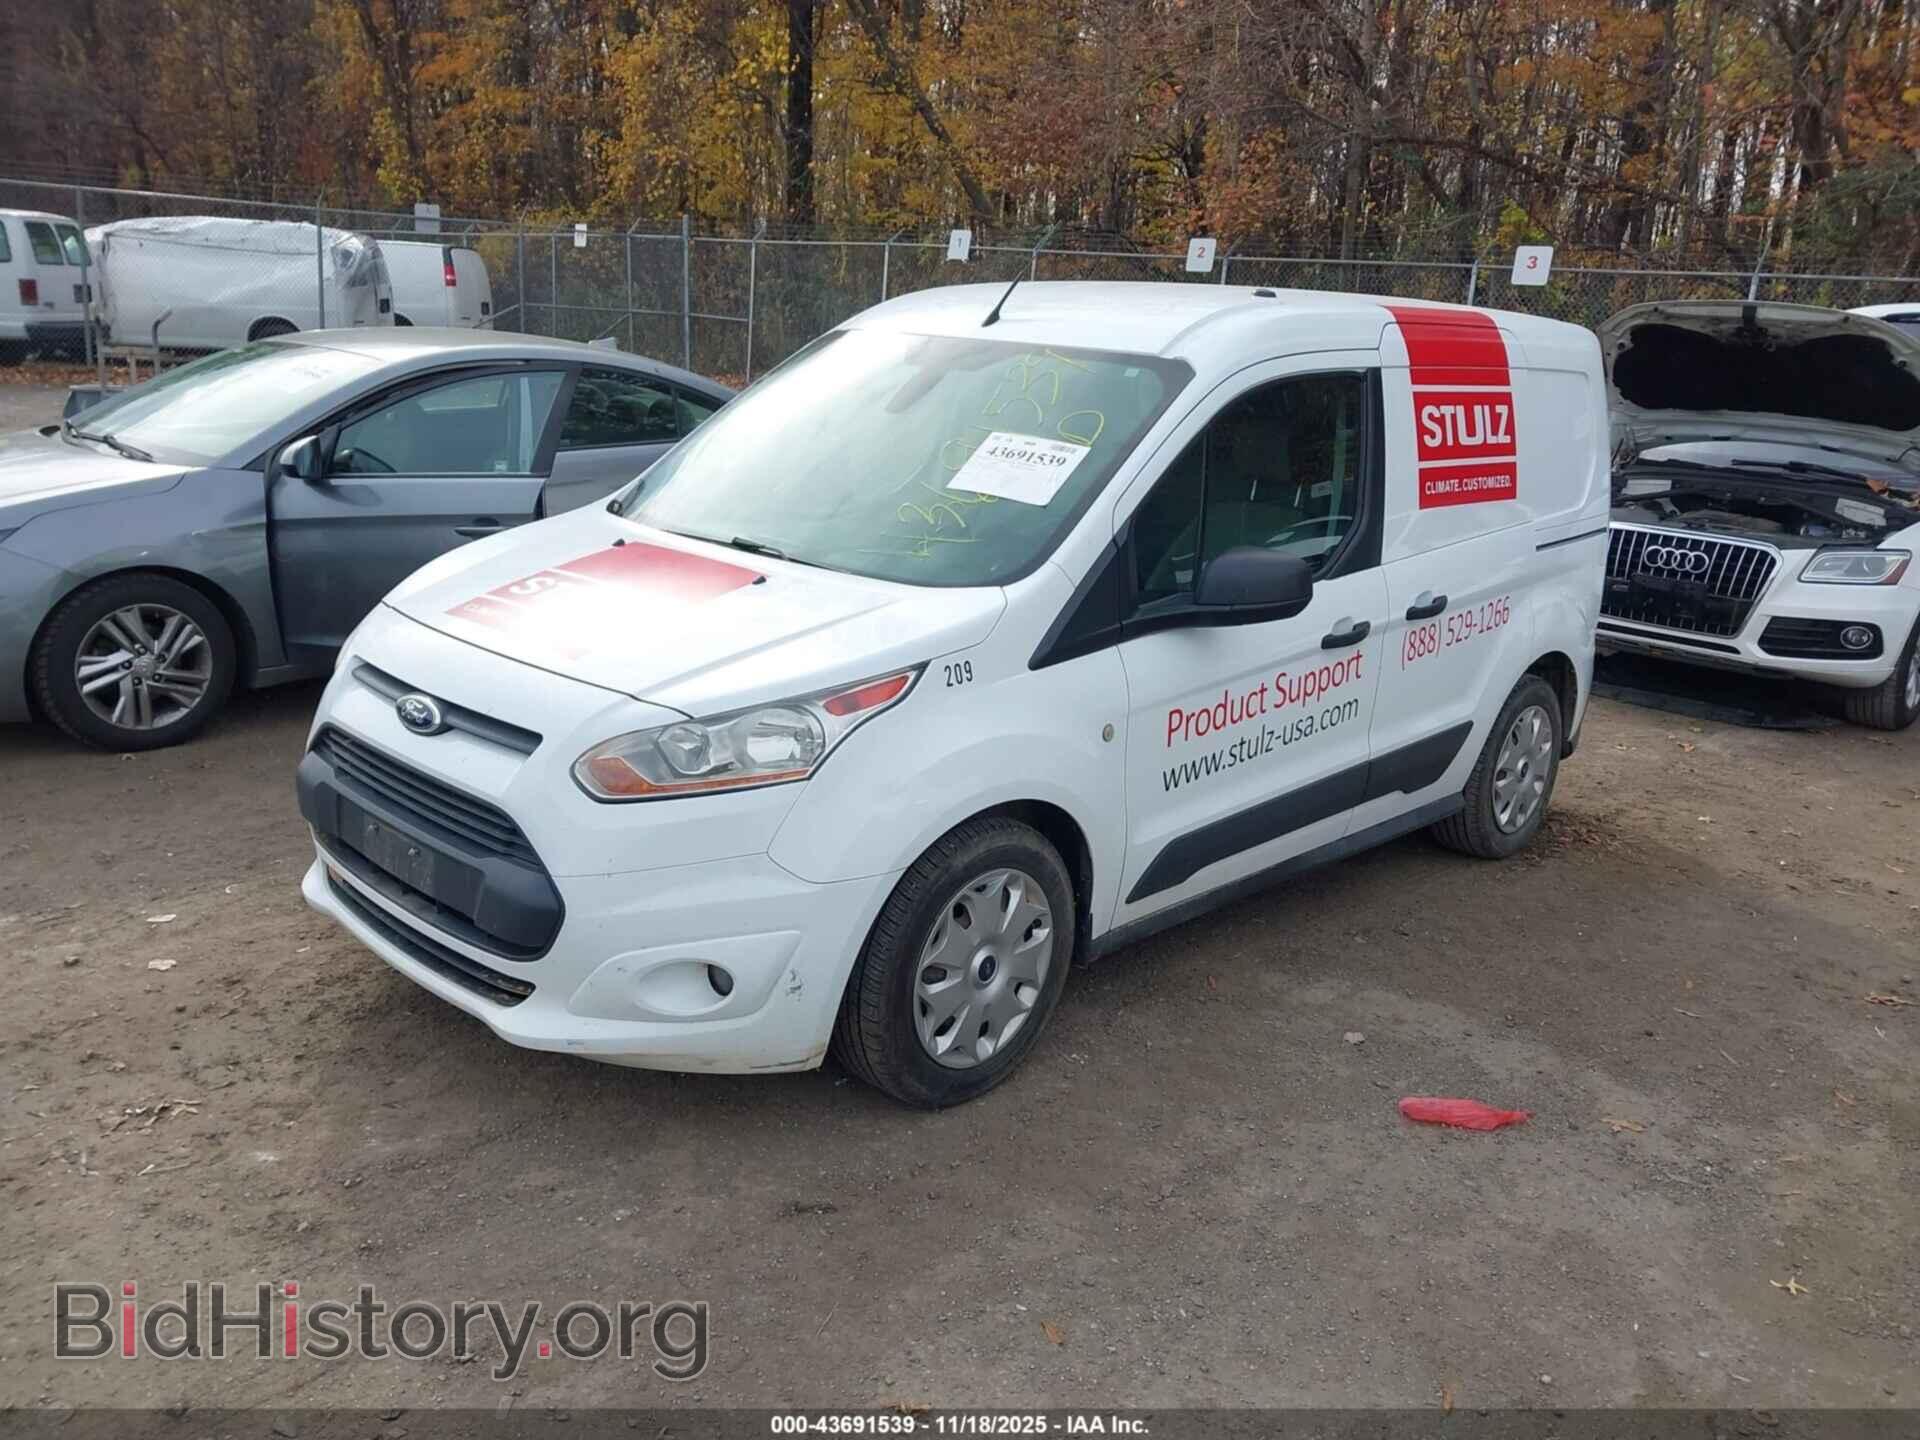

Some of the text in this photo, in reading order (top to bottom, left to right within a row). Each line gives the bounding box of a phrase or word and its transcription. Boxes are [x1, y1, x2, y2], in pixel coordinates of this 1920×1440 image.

[1197, 246, 1206, 257] 2
[1526, 255, 1538, 269] 3
[1421, 404, 1511, 447] STULZ
[986, 446, 1067, 466] 43691539
[1425, 474, 1512, 495] CLIMATE. CUSTOMIZED.
[1401, 595, 1511, 670] (888) 529-1266
[944, 660, 973, 687] 209
[1167, 649, 1362, 747] Product Support
[1162, 696, 1359, 792] www.stulz-usa.com
